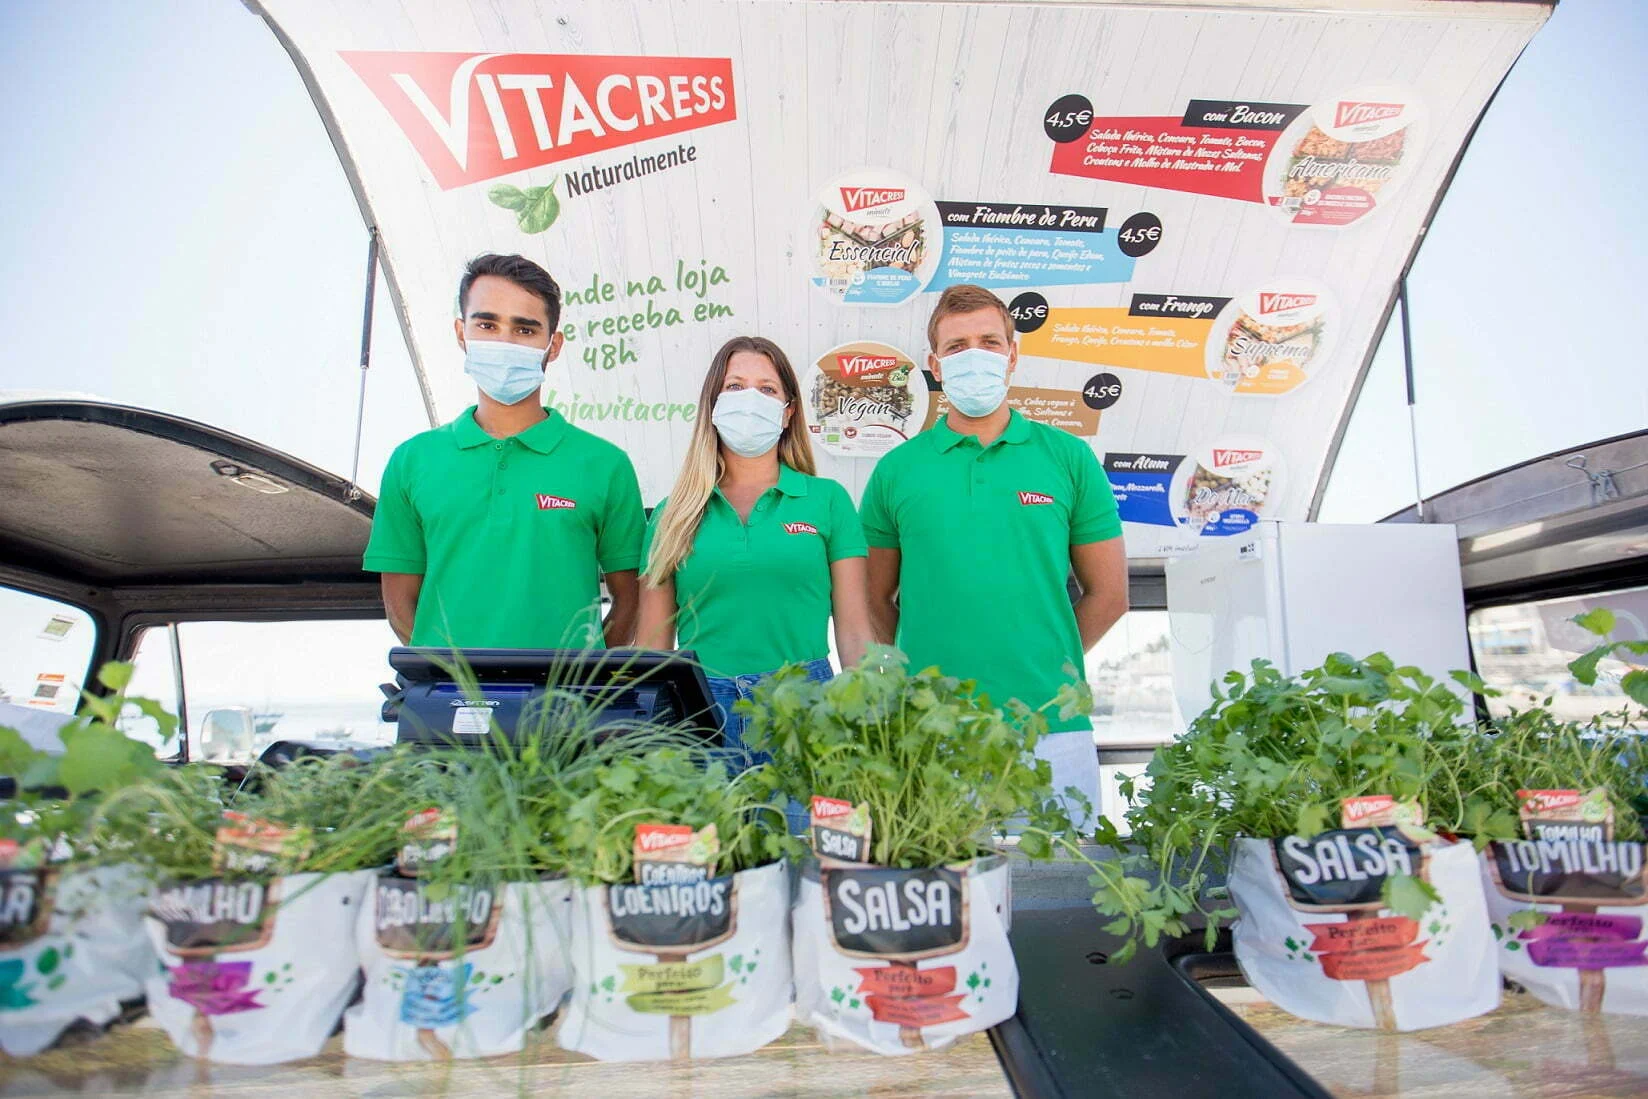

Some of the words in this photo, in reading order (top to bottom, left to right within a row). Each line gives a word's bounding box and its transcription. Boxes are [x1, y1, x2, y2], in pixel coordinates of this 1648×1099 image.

[391, 53, 726, 172] VITACRESS
[1046, 110, 1093, 129] 4,5€
[1202, 111, 1226, 123] com
[1229, 106, 1285, 125] Bacon
[1089, 129, 1122, 141] Salada
[1234, 136, 1266, 148] Bacon,
[1182, 146, 1194, 157] de
[565, 143, 698, 198] Naturalmente
[1160, 158, 1171, 169] de
[1289, 155, 1392, 179] Americana
[845, 188, 904, 209] VITACRESS
[947, 213, 969, 223] com
[972, 206, 1035, 225] Fiambre
[1038, 207, 1055, 226] de
[1060, 210, 1098, 229] Peru
[950, 232, 980, 243] Salada
[1119, 226, 1161, 244] 4,5€
[828, 239, 920, 264] Essencial
[983, 257, 993, 267] de
[984, 245, 995, 256] de
[1018, 246, 1028, 257] de
[626, 275, 667, 298] na
[676, 258, 731, 298] loja
[1009, 307, 1048, 319] 4,5€
[1138, 301, 1160, 311] com
[1161, 296, 1214, 318] Frango
[563, 322, 577, 342] e
[587, 300, 684, 338] receba
[693, 302, 735, 322] em
[582, 338, 639, 371] 48h
[1230, 336, 1313, 360] Suprema
[841, 355, 896, 376] VITACRESS
[1084, 384, 1120, 398] 4,5€
[838, 396, 890, 421] Vegan
[1113, 460, 1132, 469] com
[1132, 455, 1170, 470] Atum
[821, 829, 857, 859] SALSA
[1282, 833, 1412, 885] SALSA
[1503, 840, 1642, 878] TOMILHO
[837, 878, 952, 935] SALSA
